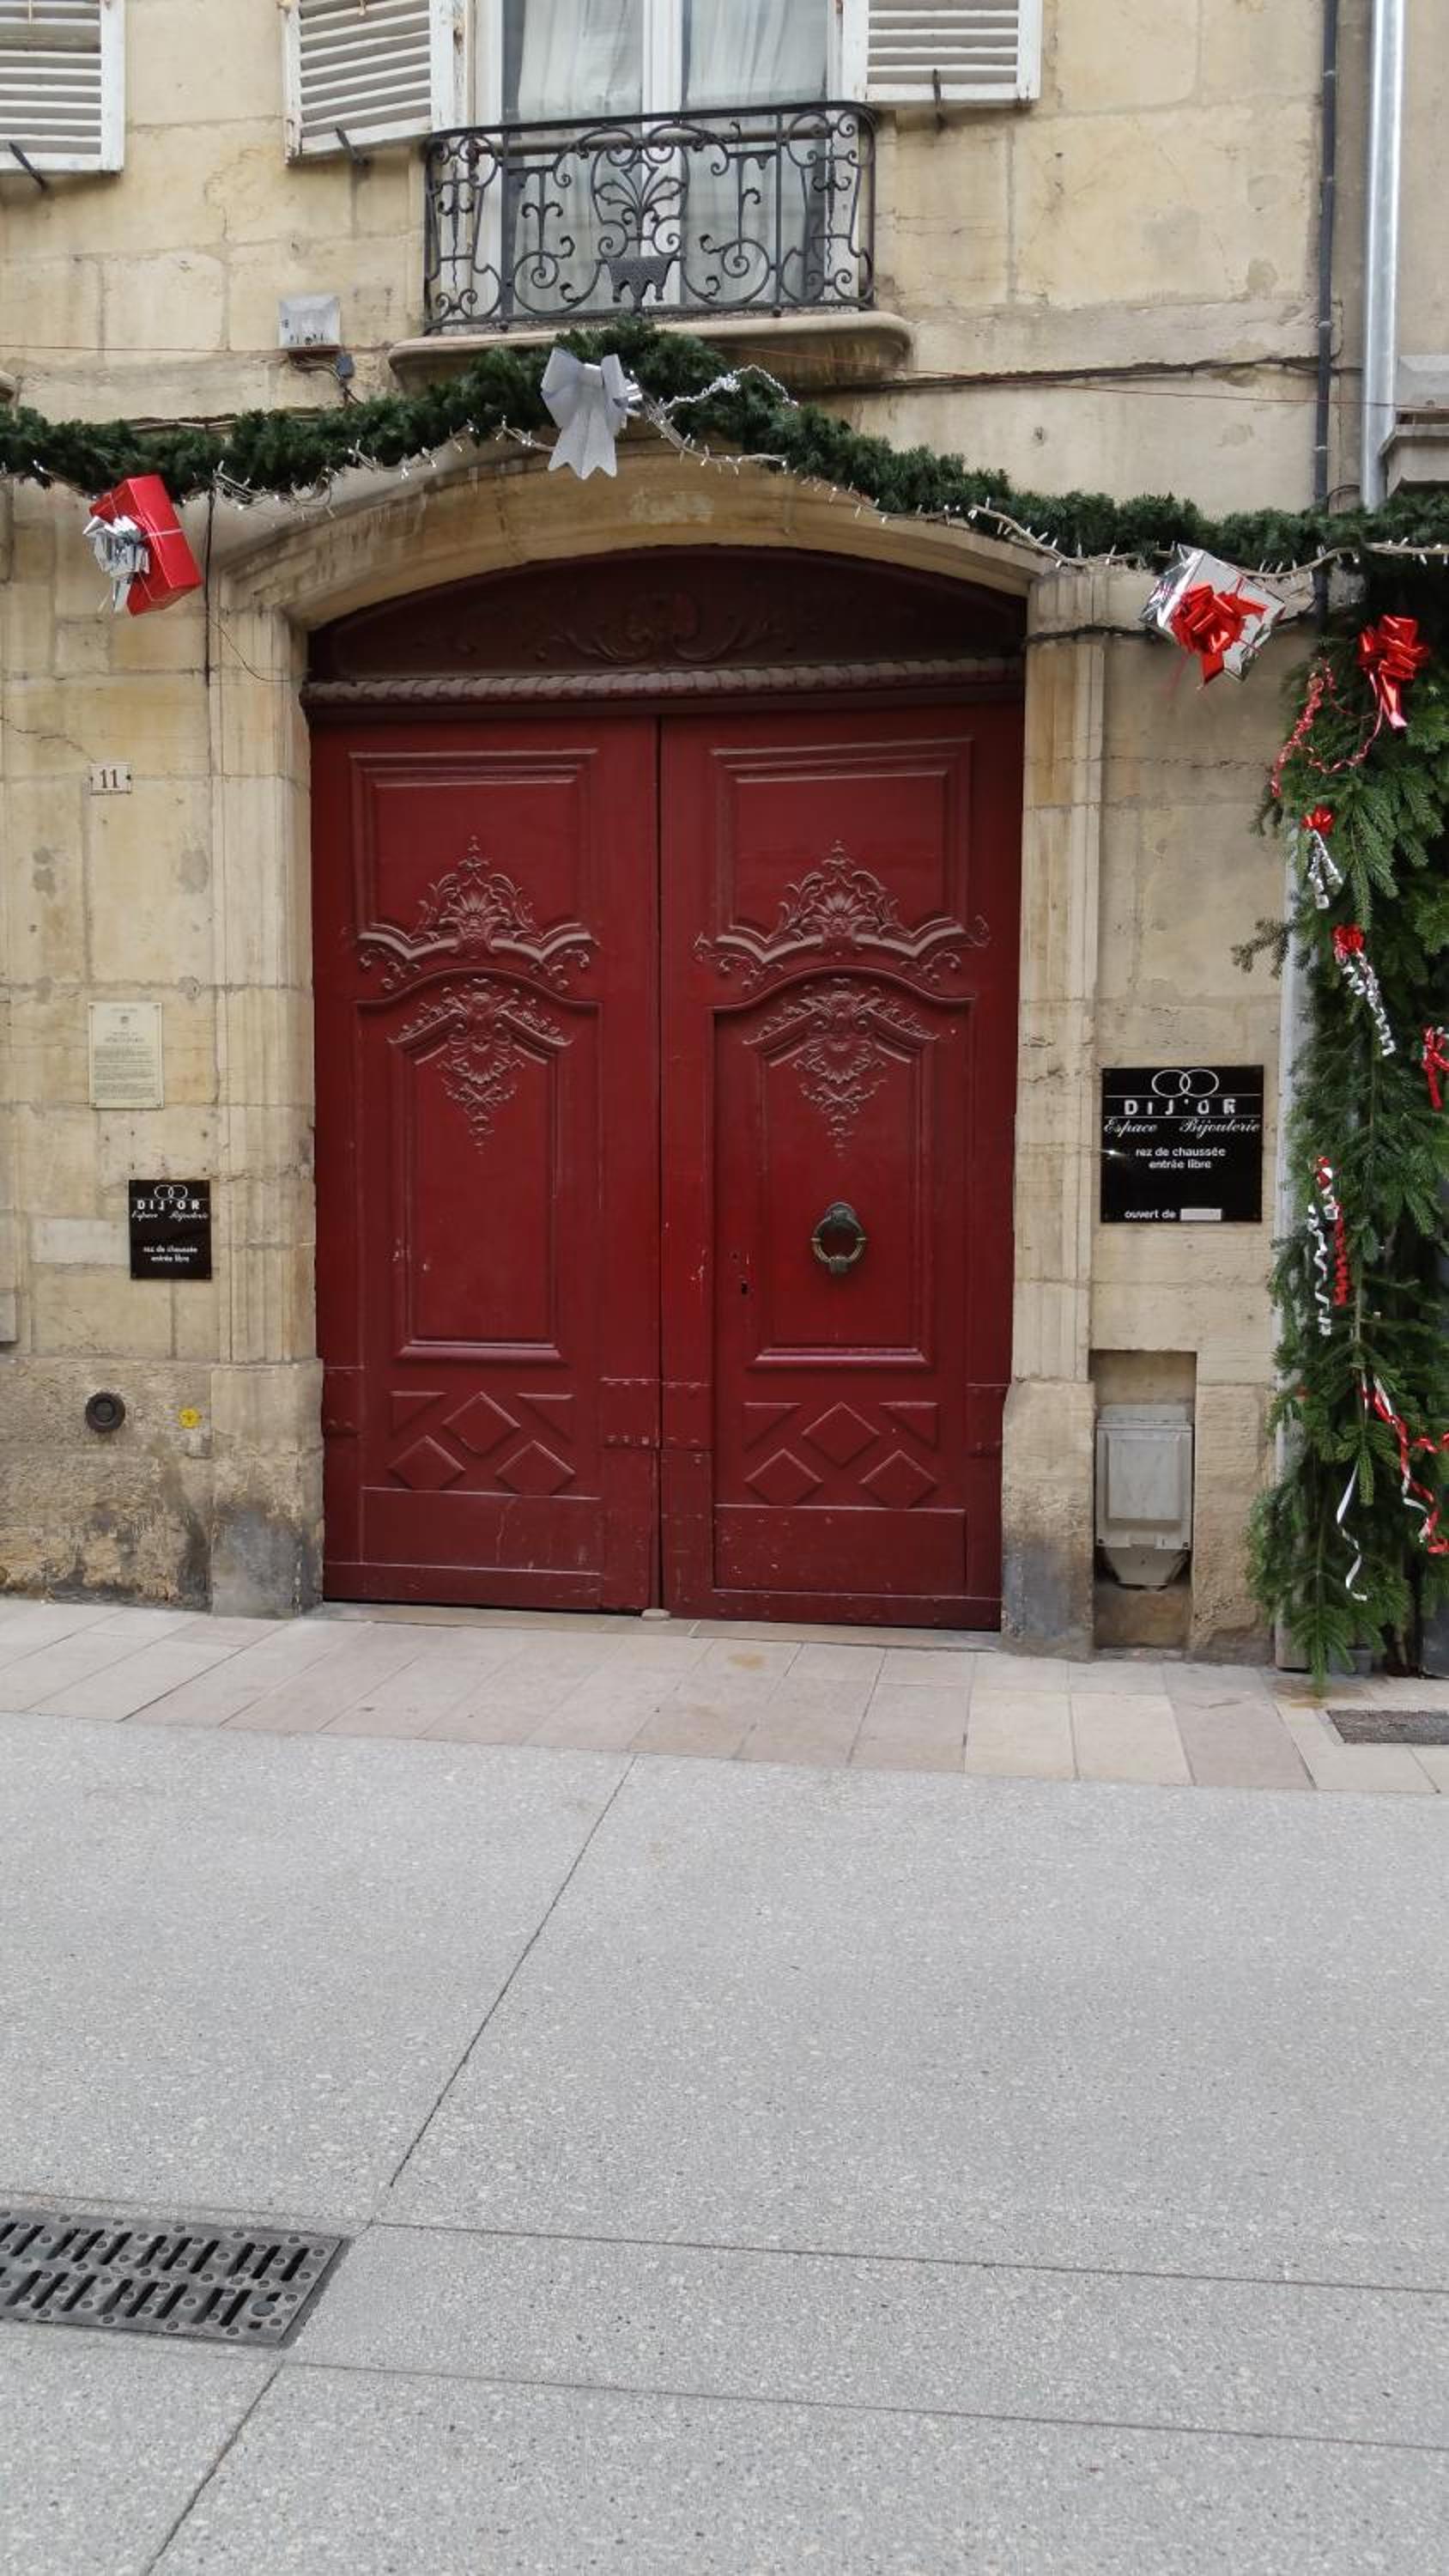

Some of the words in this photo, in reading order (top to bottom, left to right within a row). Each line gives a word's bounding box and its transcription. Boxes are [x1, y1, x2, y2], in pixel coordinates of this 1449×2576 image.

[100, 769, 120, 788] 11
[1103, 1117, 1158, 1138] Espace
[1179, 1117, 1261, 1139] Bijouterie
[1135, 1148, 1152, 1157] rez
[1155, 1146, 1169, 1157] de
[1172, 1146, 1227, 1157] chaussée
[1149, 1159, 1185, 1169] entrée
[1187, 1158, 1212, 1169] libre
[1124, 1209, 1160, 1219] ouvert
[1161, 1208, 1177, 1219] de
